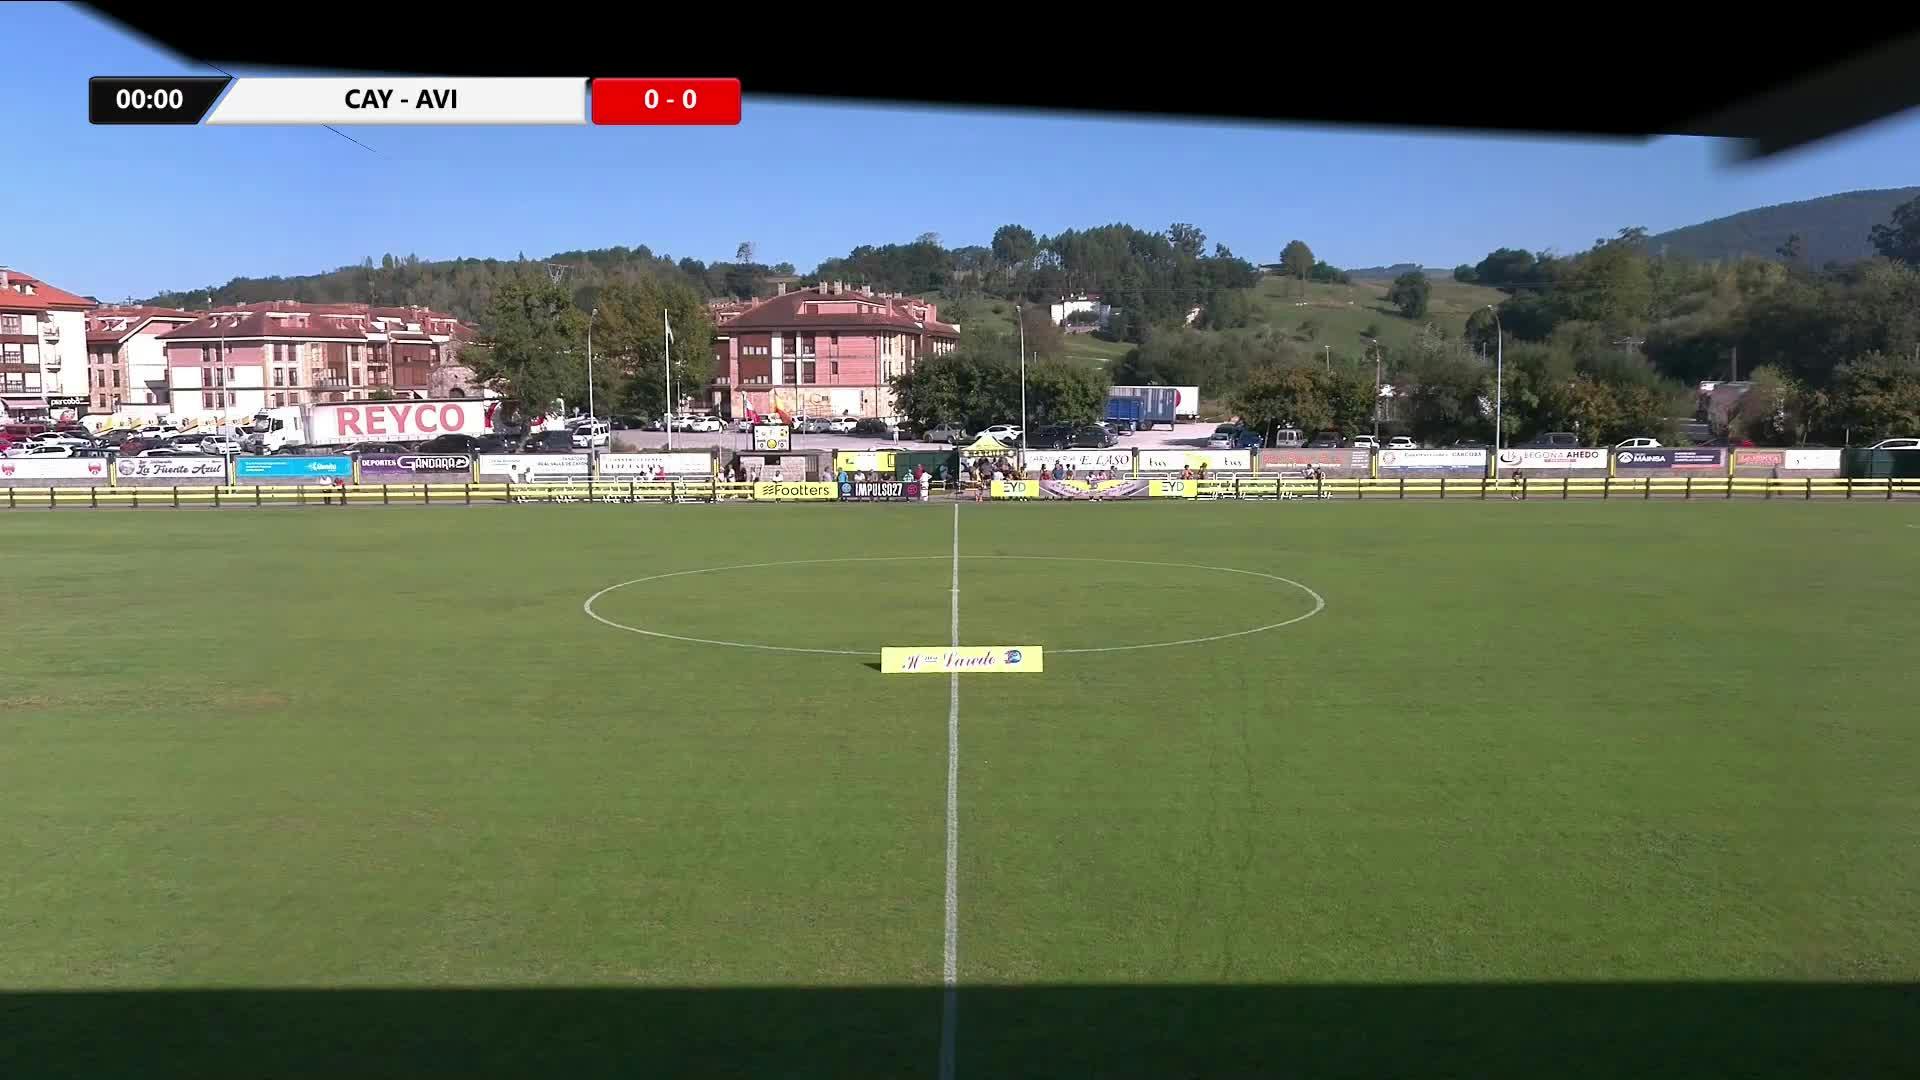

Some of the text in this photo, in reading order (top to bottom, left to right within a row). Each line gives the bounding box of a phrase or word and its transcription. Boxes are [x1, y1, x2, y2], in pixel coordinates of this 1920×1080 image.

[336, 404, 465, 436] REYCO
[1566, 451, 1599, 459] AHEDO
[361, 459, 397, 467] DEPORTES
[136, 464, 222, 475] La Fuente Azul
[774, 484, 830, 496] Footters
[855, 482, 903, 497] IMPULSO27
